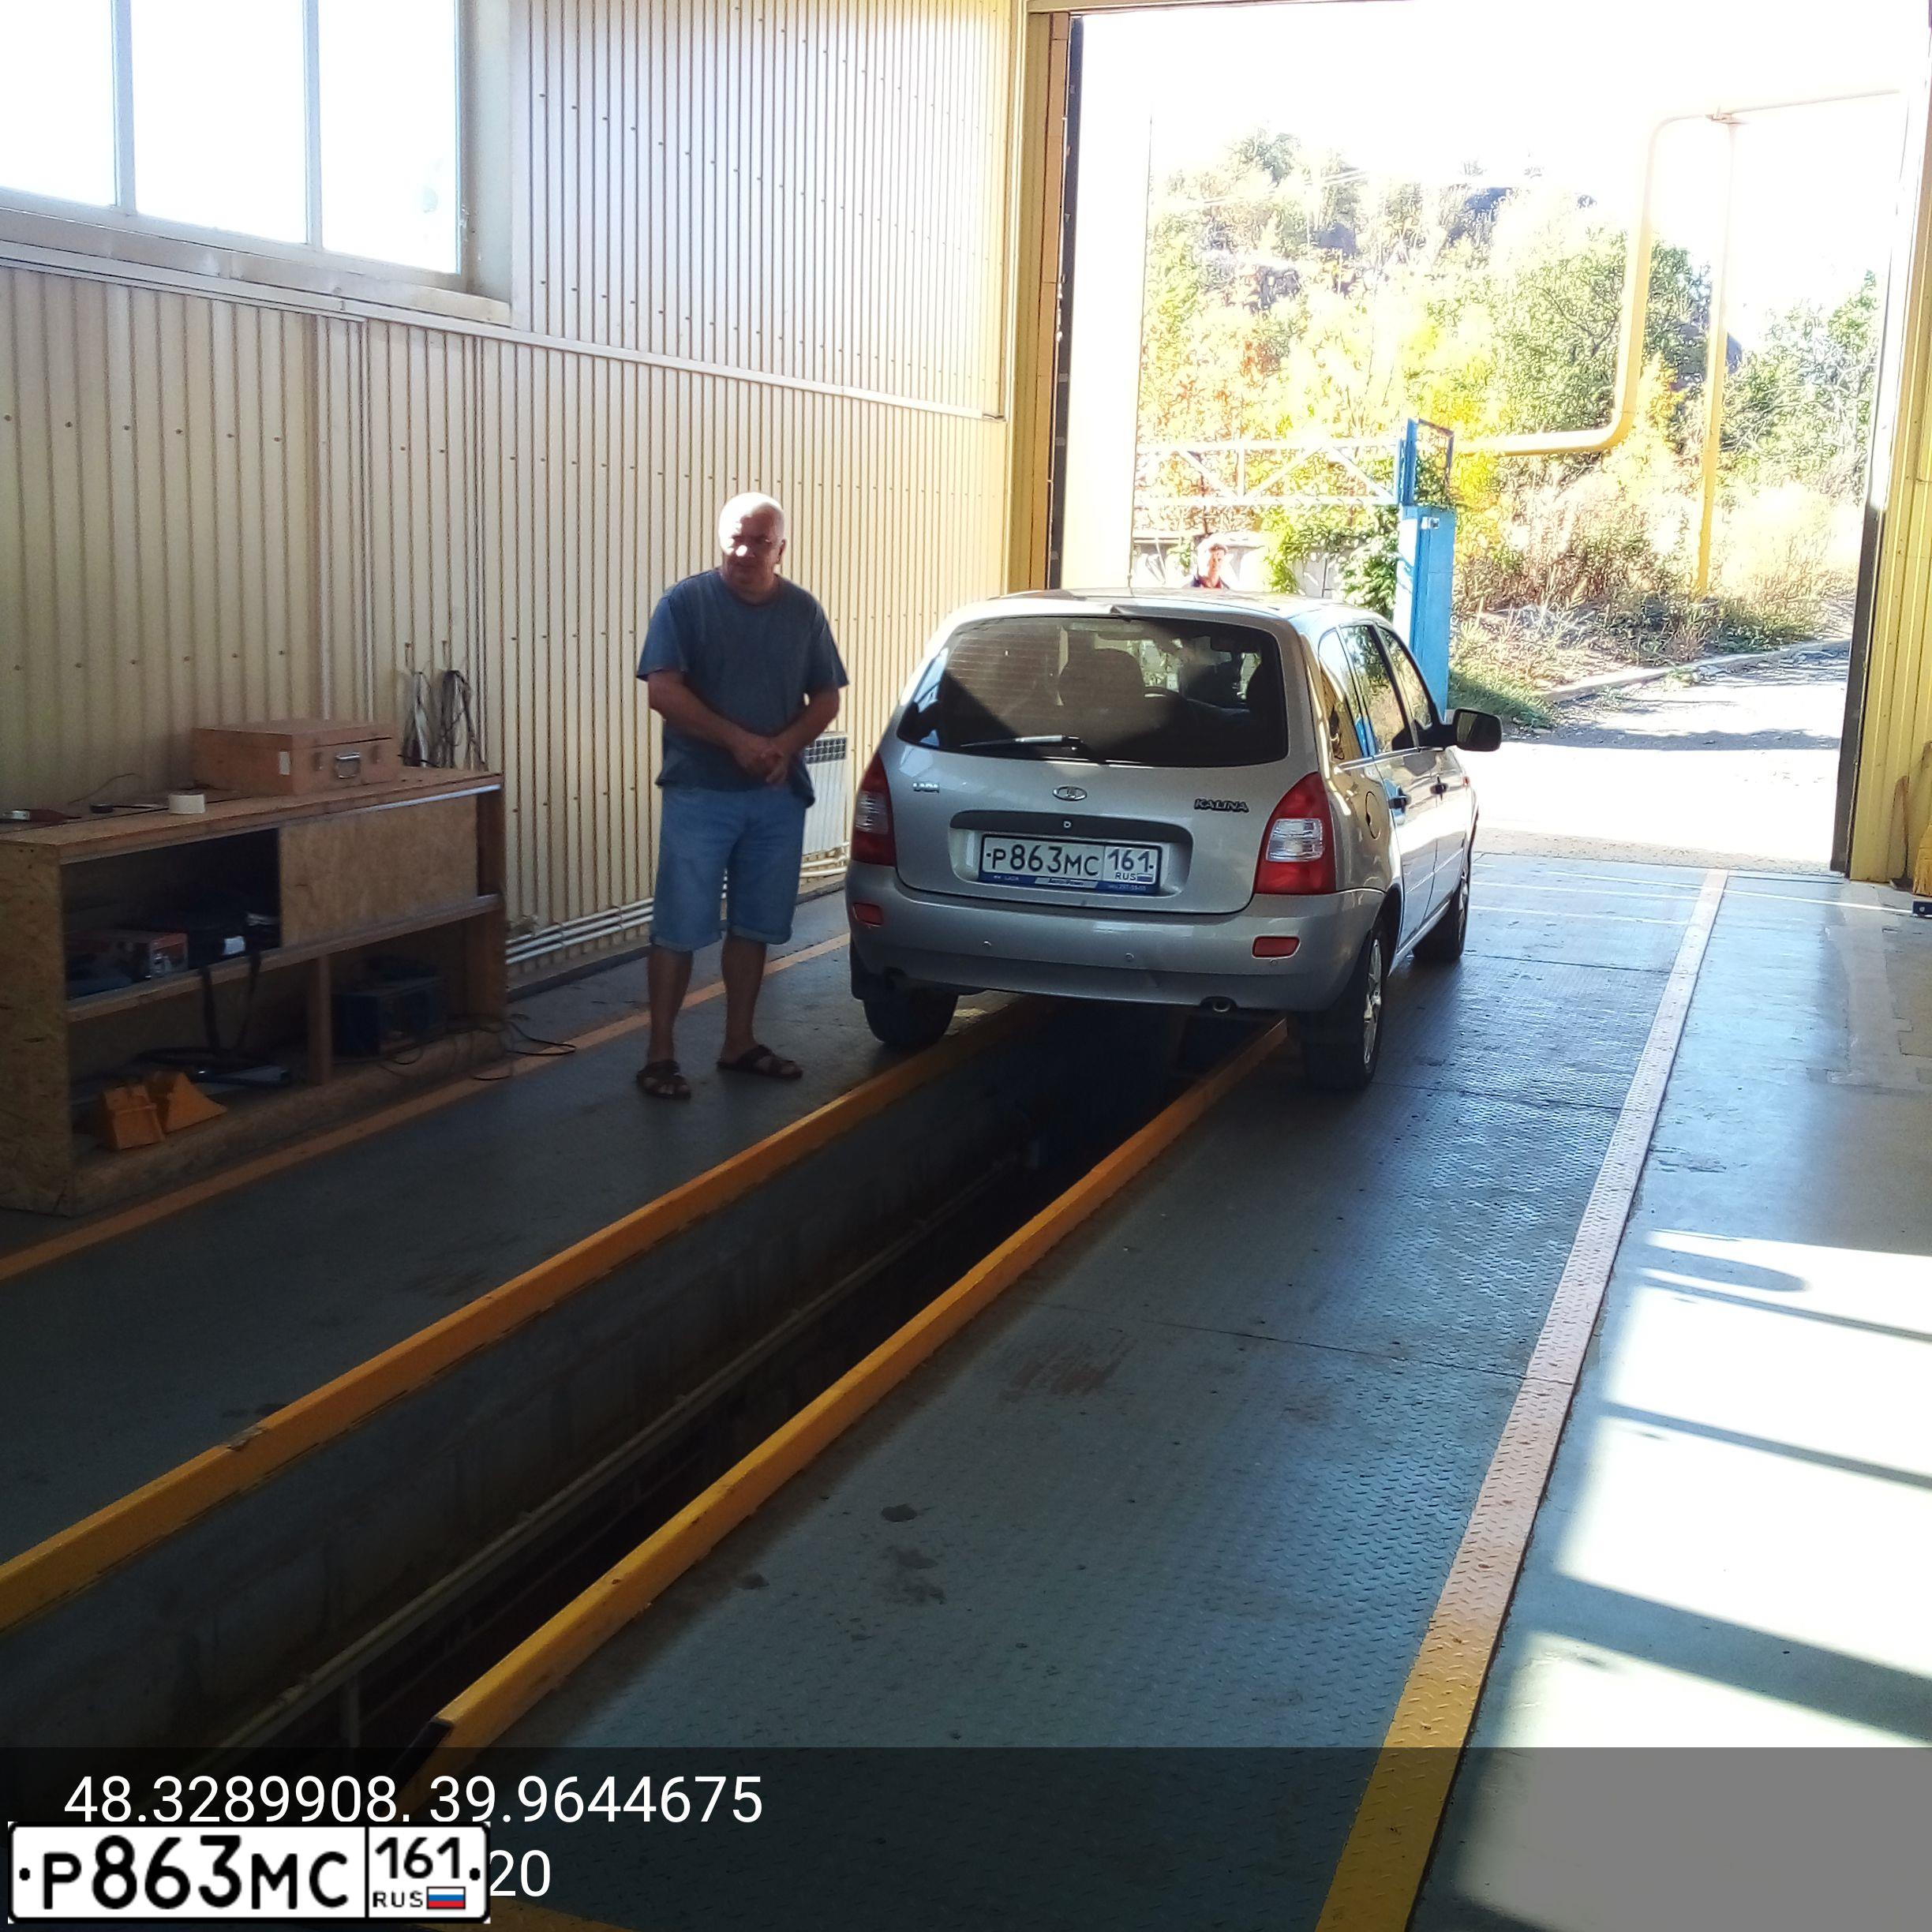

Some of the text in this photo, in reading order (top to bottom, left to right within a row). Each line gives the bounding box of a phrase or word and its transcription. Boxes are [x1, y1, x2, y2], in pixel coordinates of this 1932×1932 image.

[1194, 798, 1249, 813] KALINA
[1106, 848, 1150, 873] 161
[1114, 871, 1136, 881] RUS
